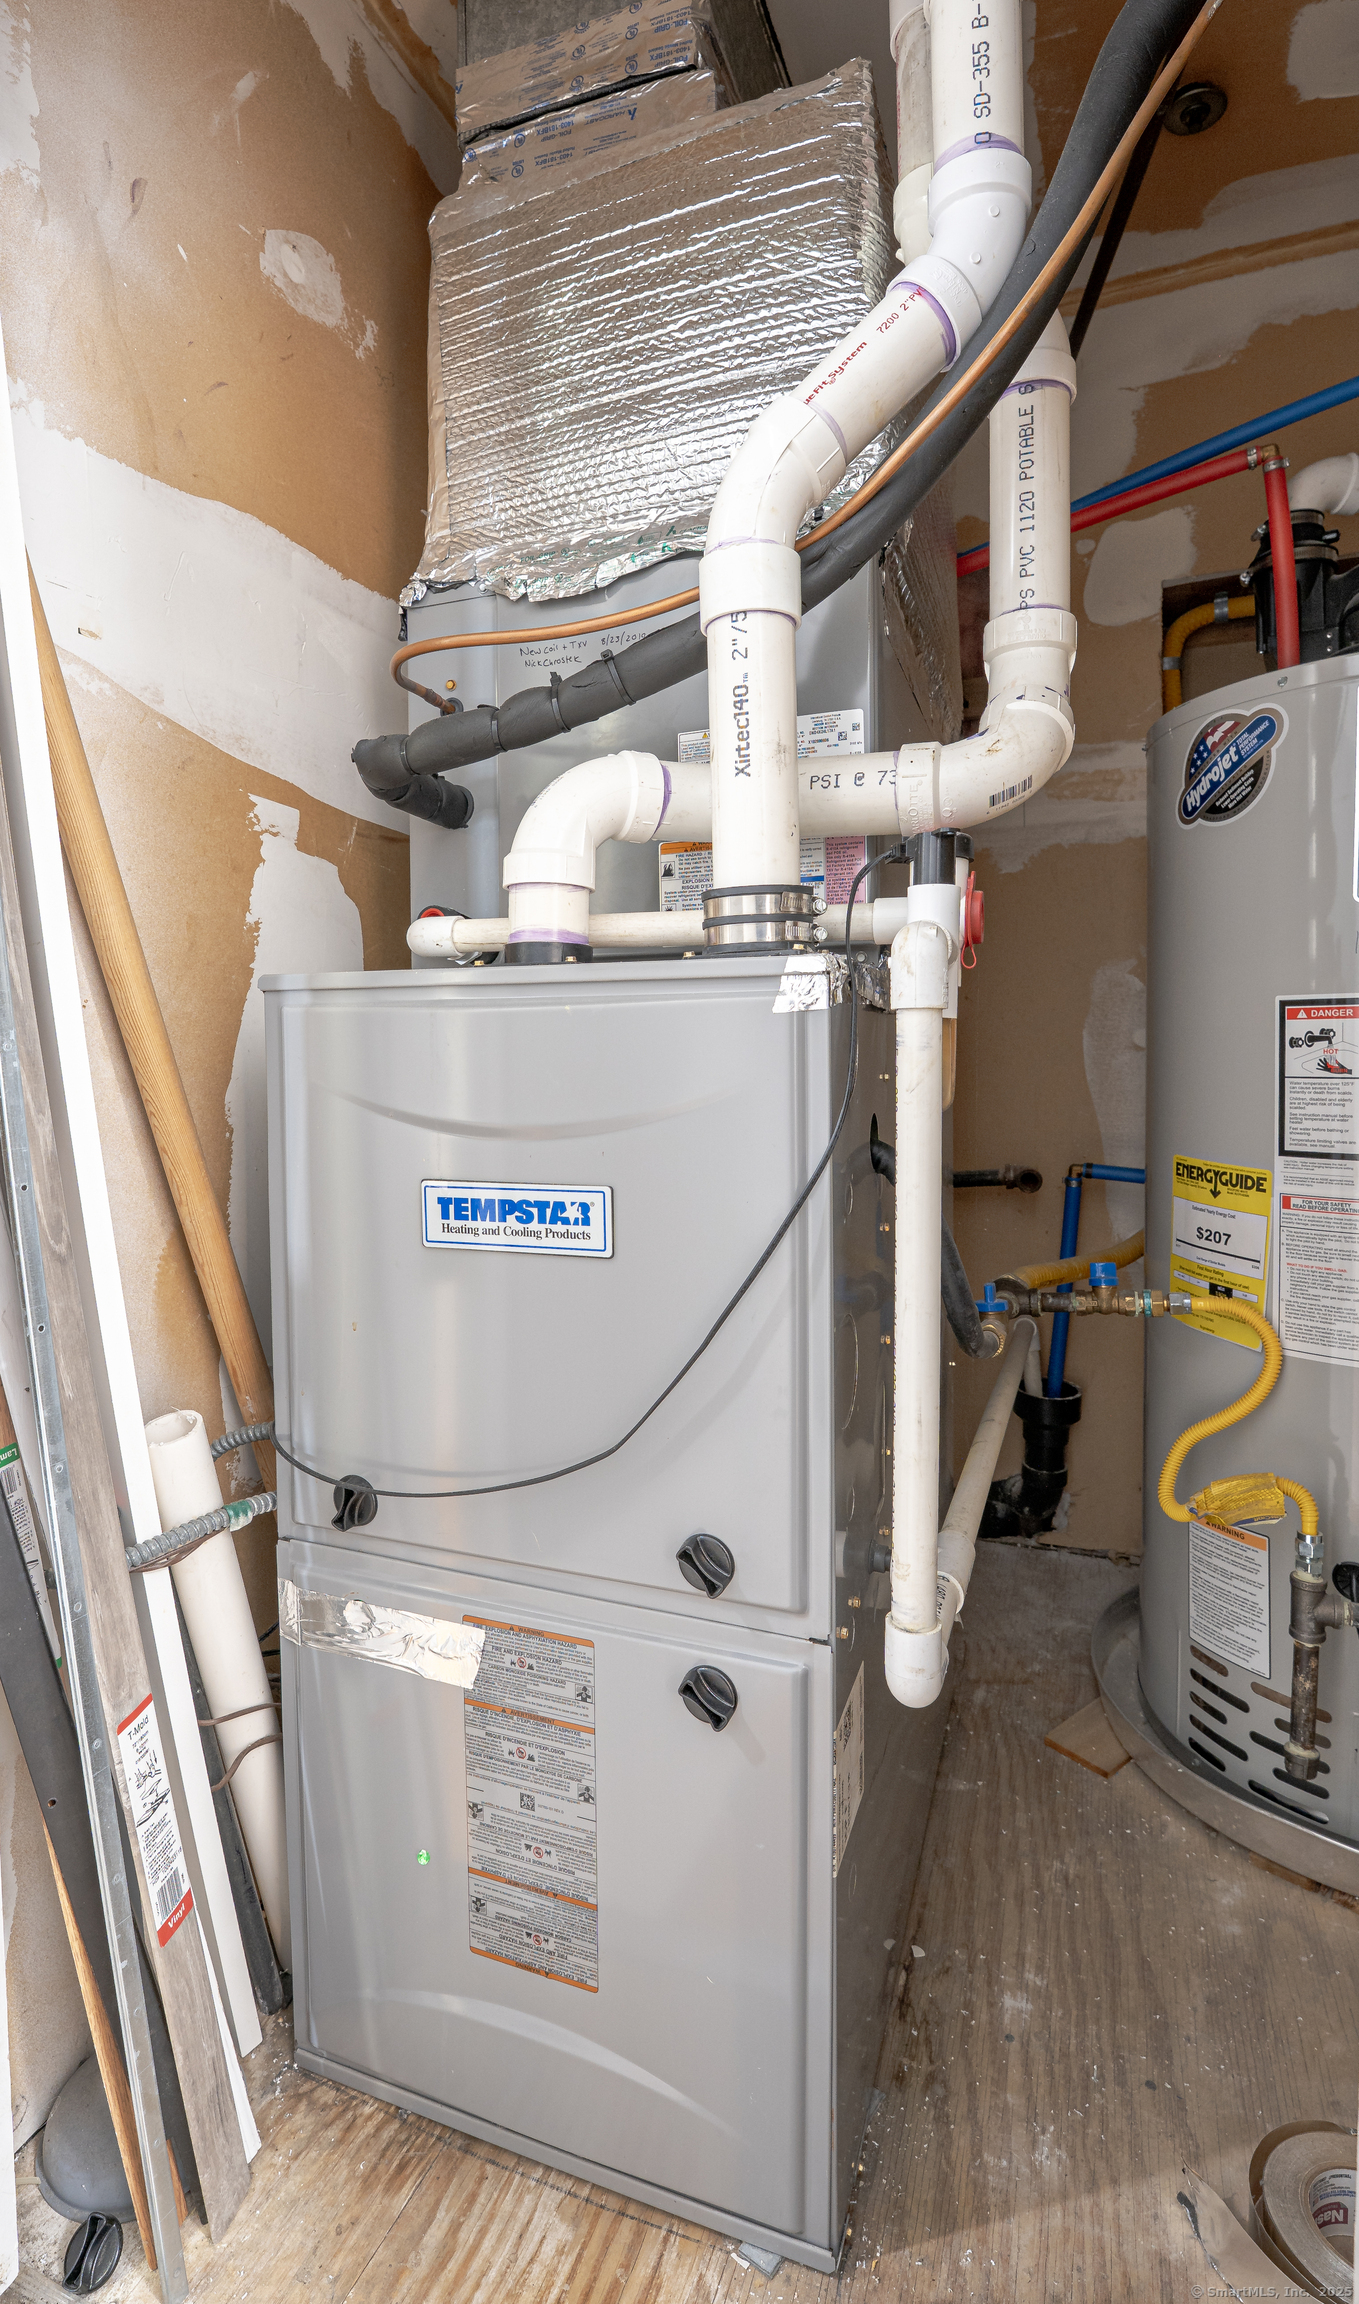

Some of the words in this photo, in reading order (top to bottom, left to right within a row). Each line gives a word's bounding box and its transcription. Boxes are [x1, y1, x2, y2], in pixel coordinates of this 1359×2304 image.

[653, 19, 688, 33] FOIL-GRIP
[653, 55, 688, 67] FOIL-GRIP
[971, 41, 991, 119] SD-355
[541, 129, 572, 142] FOIL-GRIP
[876, 312, 900, 333] 7200
[827, 341, 868, 380] System
[1018, 405, 1034, 482] POTABLE
[1018, 490, 1034, 533] 1120
[1018, 545, 1034, 578] PVC
[519, 646, 542, 656] New
[1236, 731, 1250, 746] TOTAL
[1238, 719, 1270, 751] PERFORMANCE
[1240, 737, 1258, 756] SYSTEM
[810, 773, 841, 790] PSI
[853, 771, 865, 788] @
[1185, 744, 1239, 812] Hydrojet
[1311, 1009, 1354, 1018] DANGER
[1175, 1161, 1268, 1196] ENERGYGUIDE
[437, 1196, 592, 1227] TEMPSTAR
[1215, 1209, 1227, 1219] Energy
[441, 1223, 480, 1238] Heating
[481, 1226, 501, 1237] and
[503, 1225, 543, 1240] Cooling
[545, 1228, 593, 1241] Products
[1196, 1225, 1231, 1246] $207
[0, 1447, 18, 1465] Lam
[1210, 1521, 1246, 1540] WARNING
[517, 1626, 545, 1638] WARNING
[514, 1650, 542, 1661] EXPLOSION
[542, 1656, 563, 1666] HAZARD
[509, 1708, 556, 1725] AVERTISSEMENT
[127, 1714, 150, 1741] T-Mold
[485, 1731, 502, 1741] RISQUE
[503, 1734, 528, 1747] D'INCENDIE
[534, 1742, 566, 1756] D'EXPLOSION
[495, 1848, 525, 1862] D'EXPLOSION
[532, 1859, 558, 1871] D'INCENDIE
[558, 1866, 576, 1876] RISQUE
[504, 1879, 550, 1897] AVERTISSEMENT
[168, 1902, 186, 1929] Vinyl
[498, 1933, 516, 1945] HAZARD
[516, 1941, 546, 1953] EXPLOSION
[546, 1949, 557, 1957] AND
[557, 1953, 569, 1961] FIRE
[515, 1962, 541, 1976] WARNING
